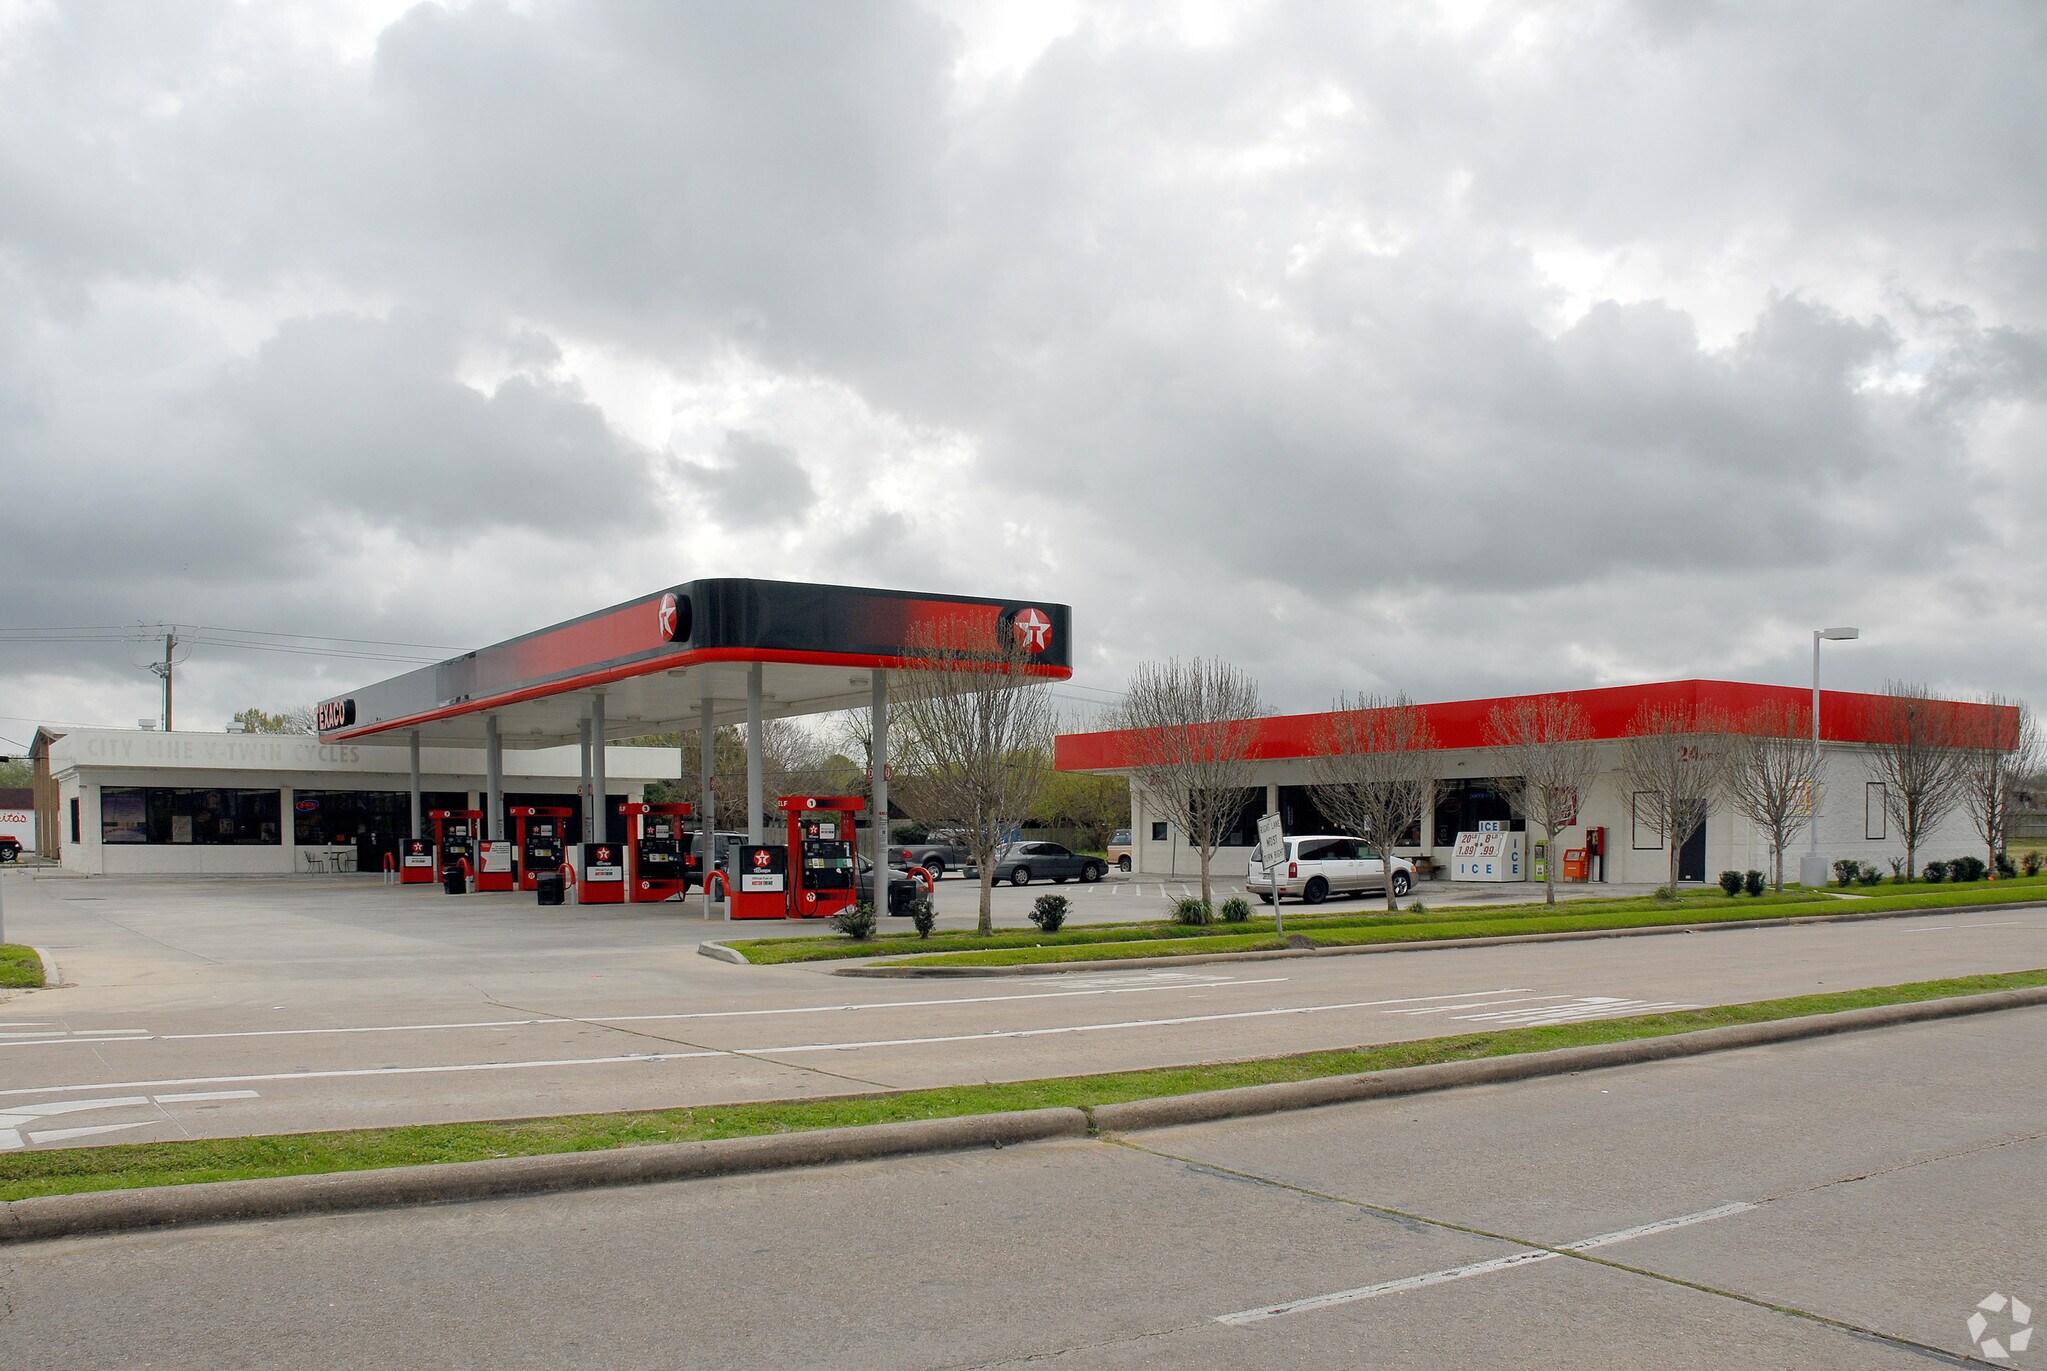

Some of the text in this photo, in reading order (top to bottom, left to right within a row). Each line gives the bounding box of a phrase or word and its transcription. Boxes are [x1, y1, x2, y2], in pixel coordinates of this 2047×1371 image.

[318, 699, 345, 730] EXACO
[87, 739, 132, 757] CITY
[145, 741, 193, 759] LINE
[294, 744, 360, 763] CYCLES
[1480, 822, 1498, 831] ICE
[1266, 835, 1278, 847] MUST
[1458, 846, 1494, 855] 1.89 .99
[1461, 864, 1492, 873] ICE
